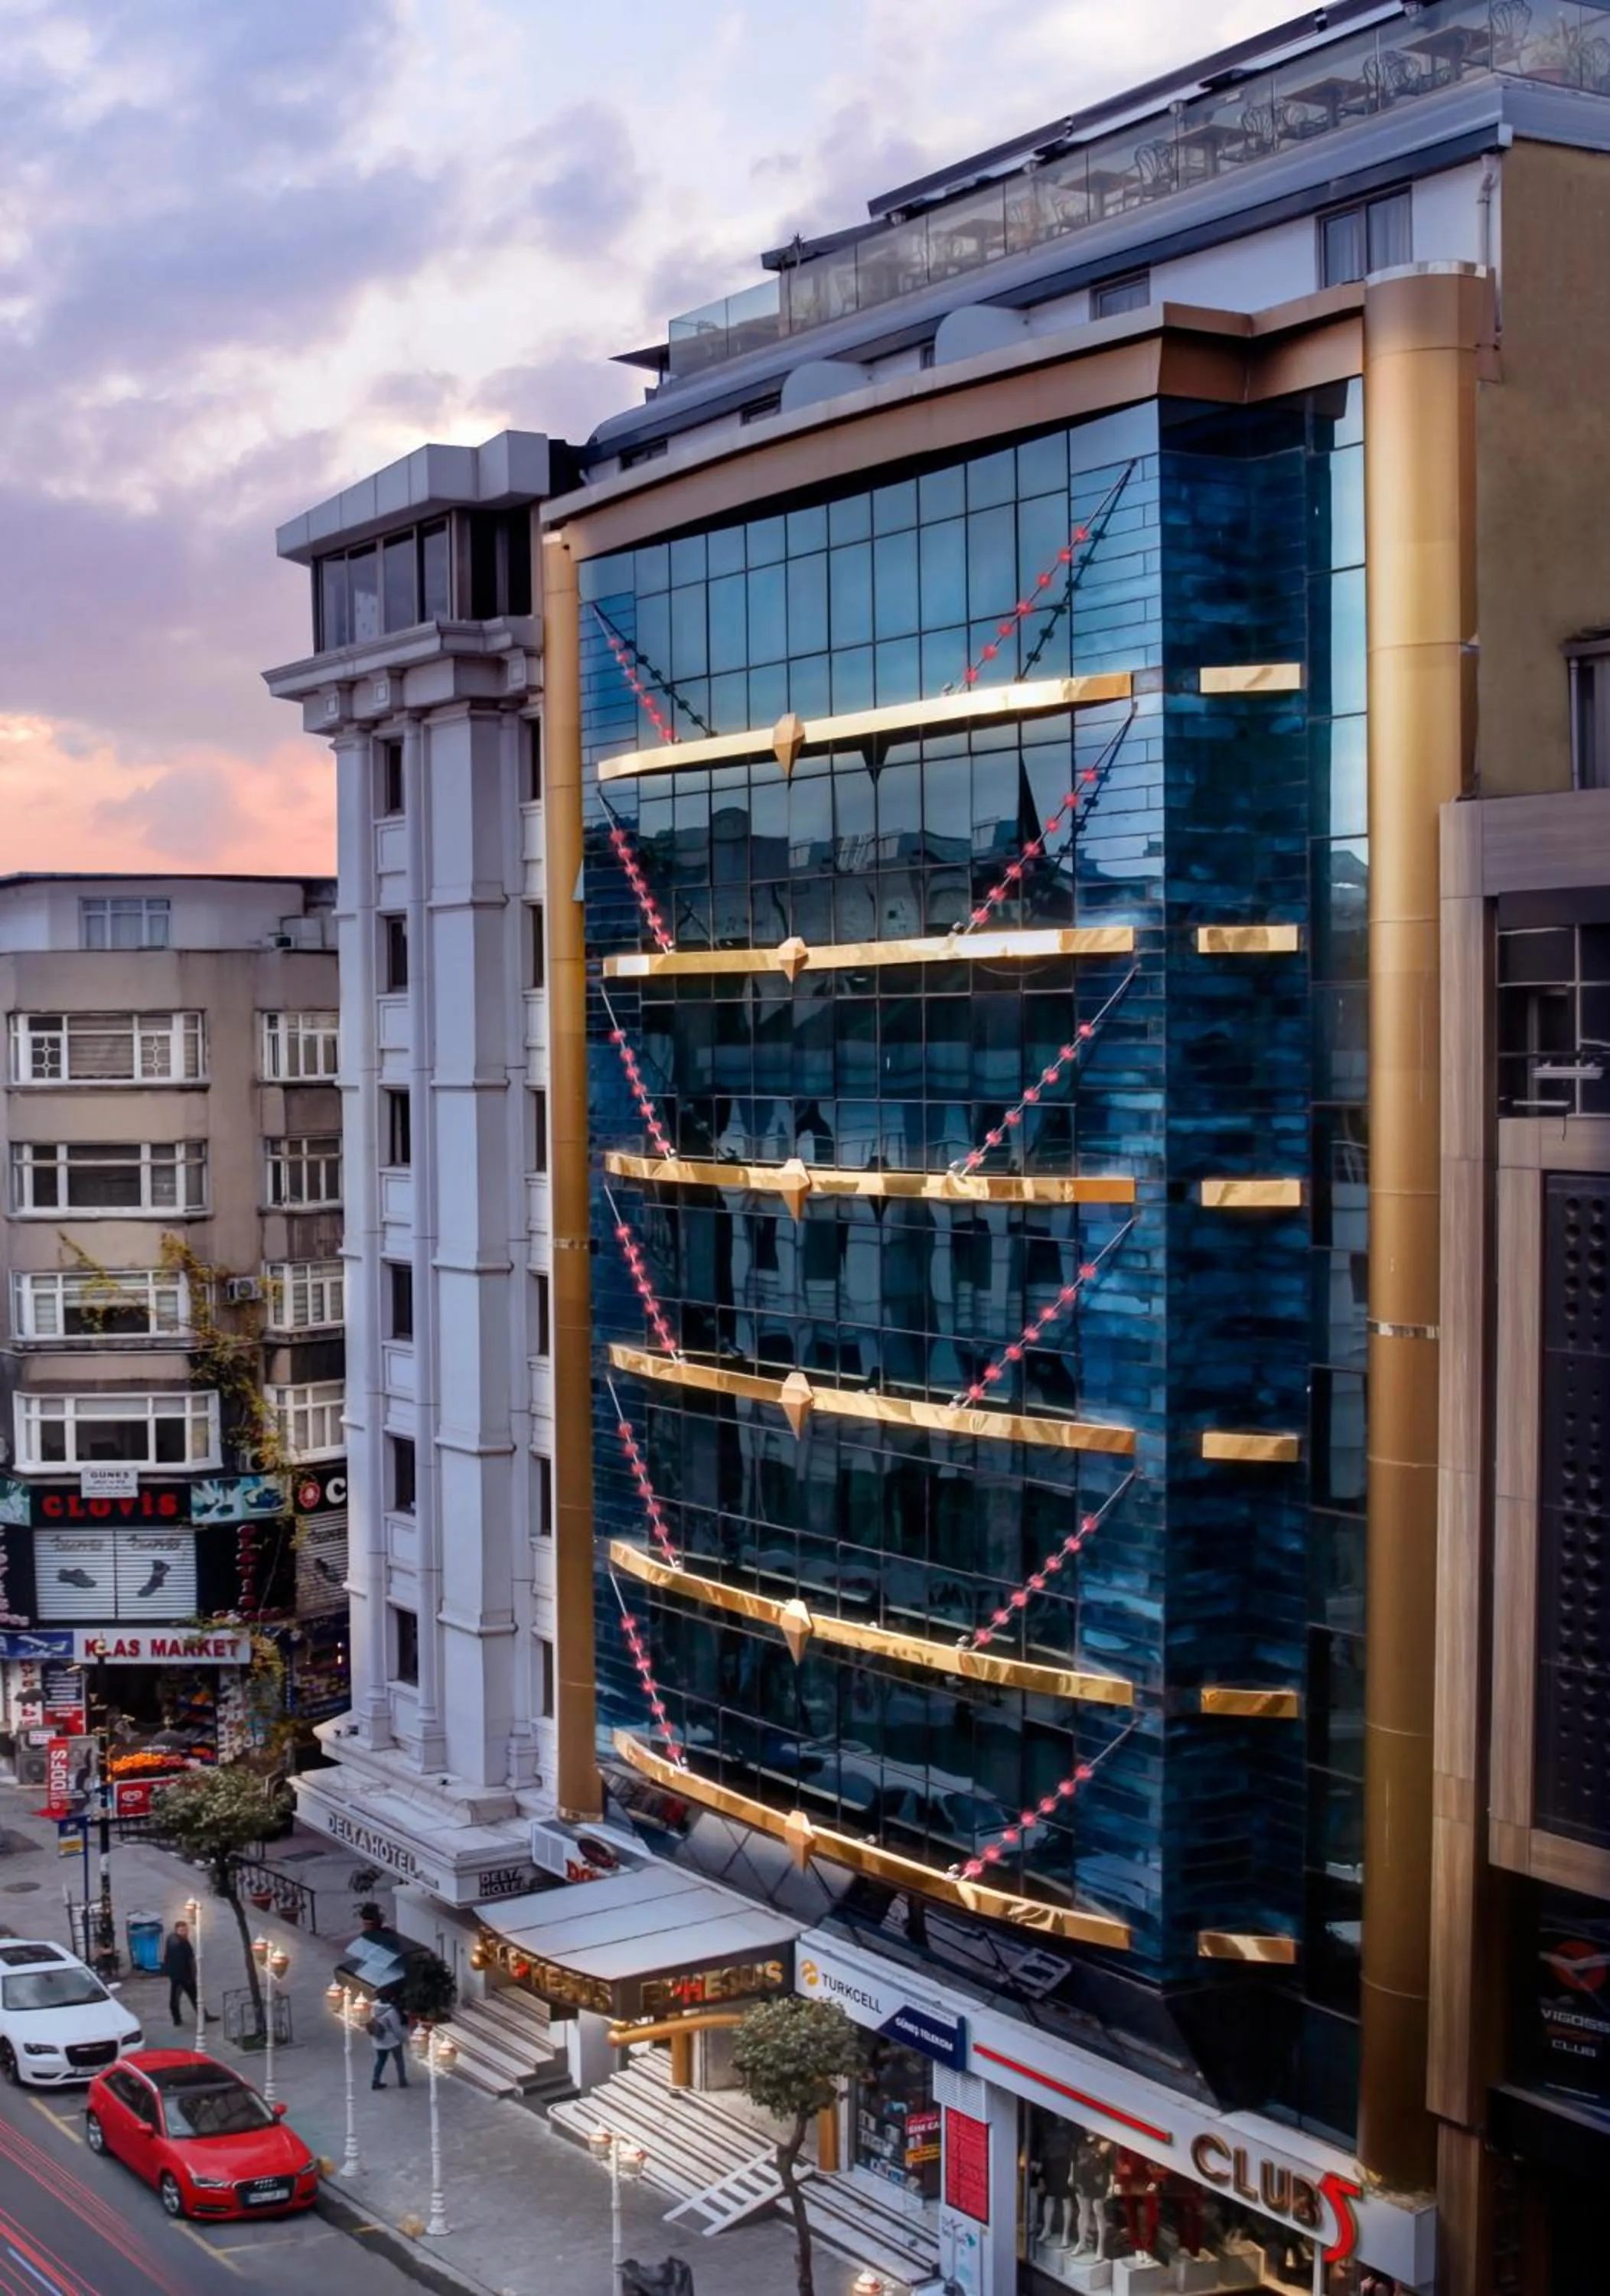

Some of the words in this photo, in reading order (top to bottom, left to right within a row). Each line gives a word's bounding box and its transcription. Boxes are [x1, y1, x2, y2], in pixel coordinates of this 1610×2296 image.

[84, 1638, 140, 1657] KAS
[151, 1638, 240, 1658] MARKET
[328, 1813, 369, 1851] DELTA
[370, 1837, 418, 1876] HOTEL
[640, 1959, 784, 2011] EPHESUS
[822, 1972, 882, 2014] TURKCELL
[1191, 2132, 1324, 2230] CLUB
